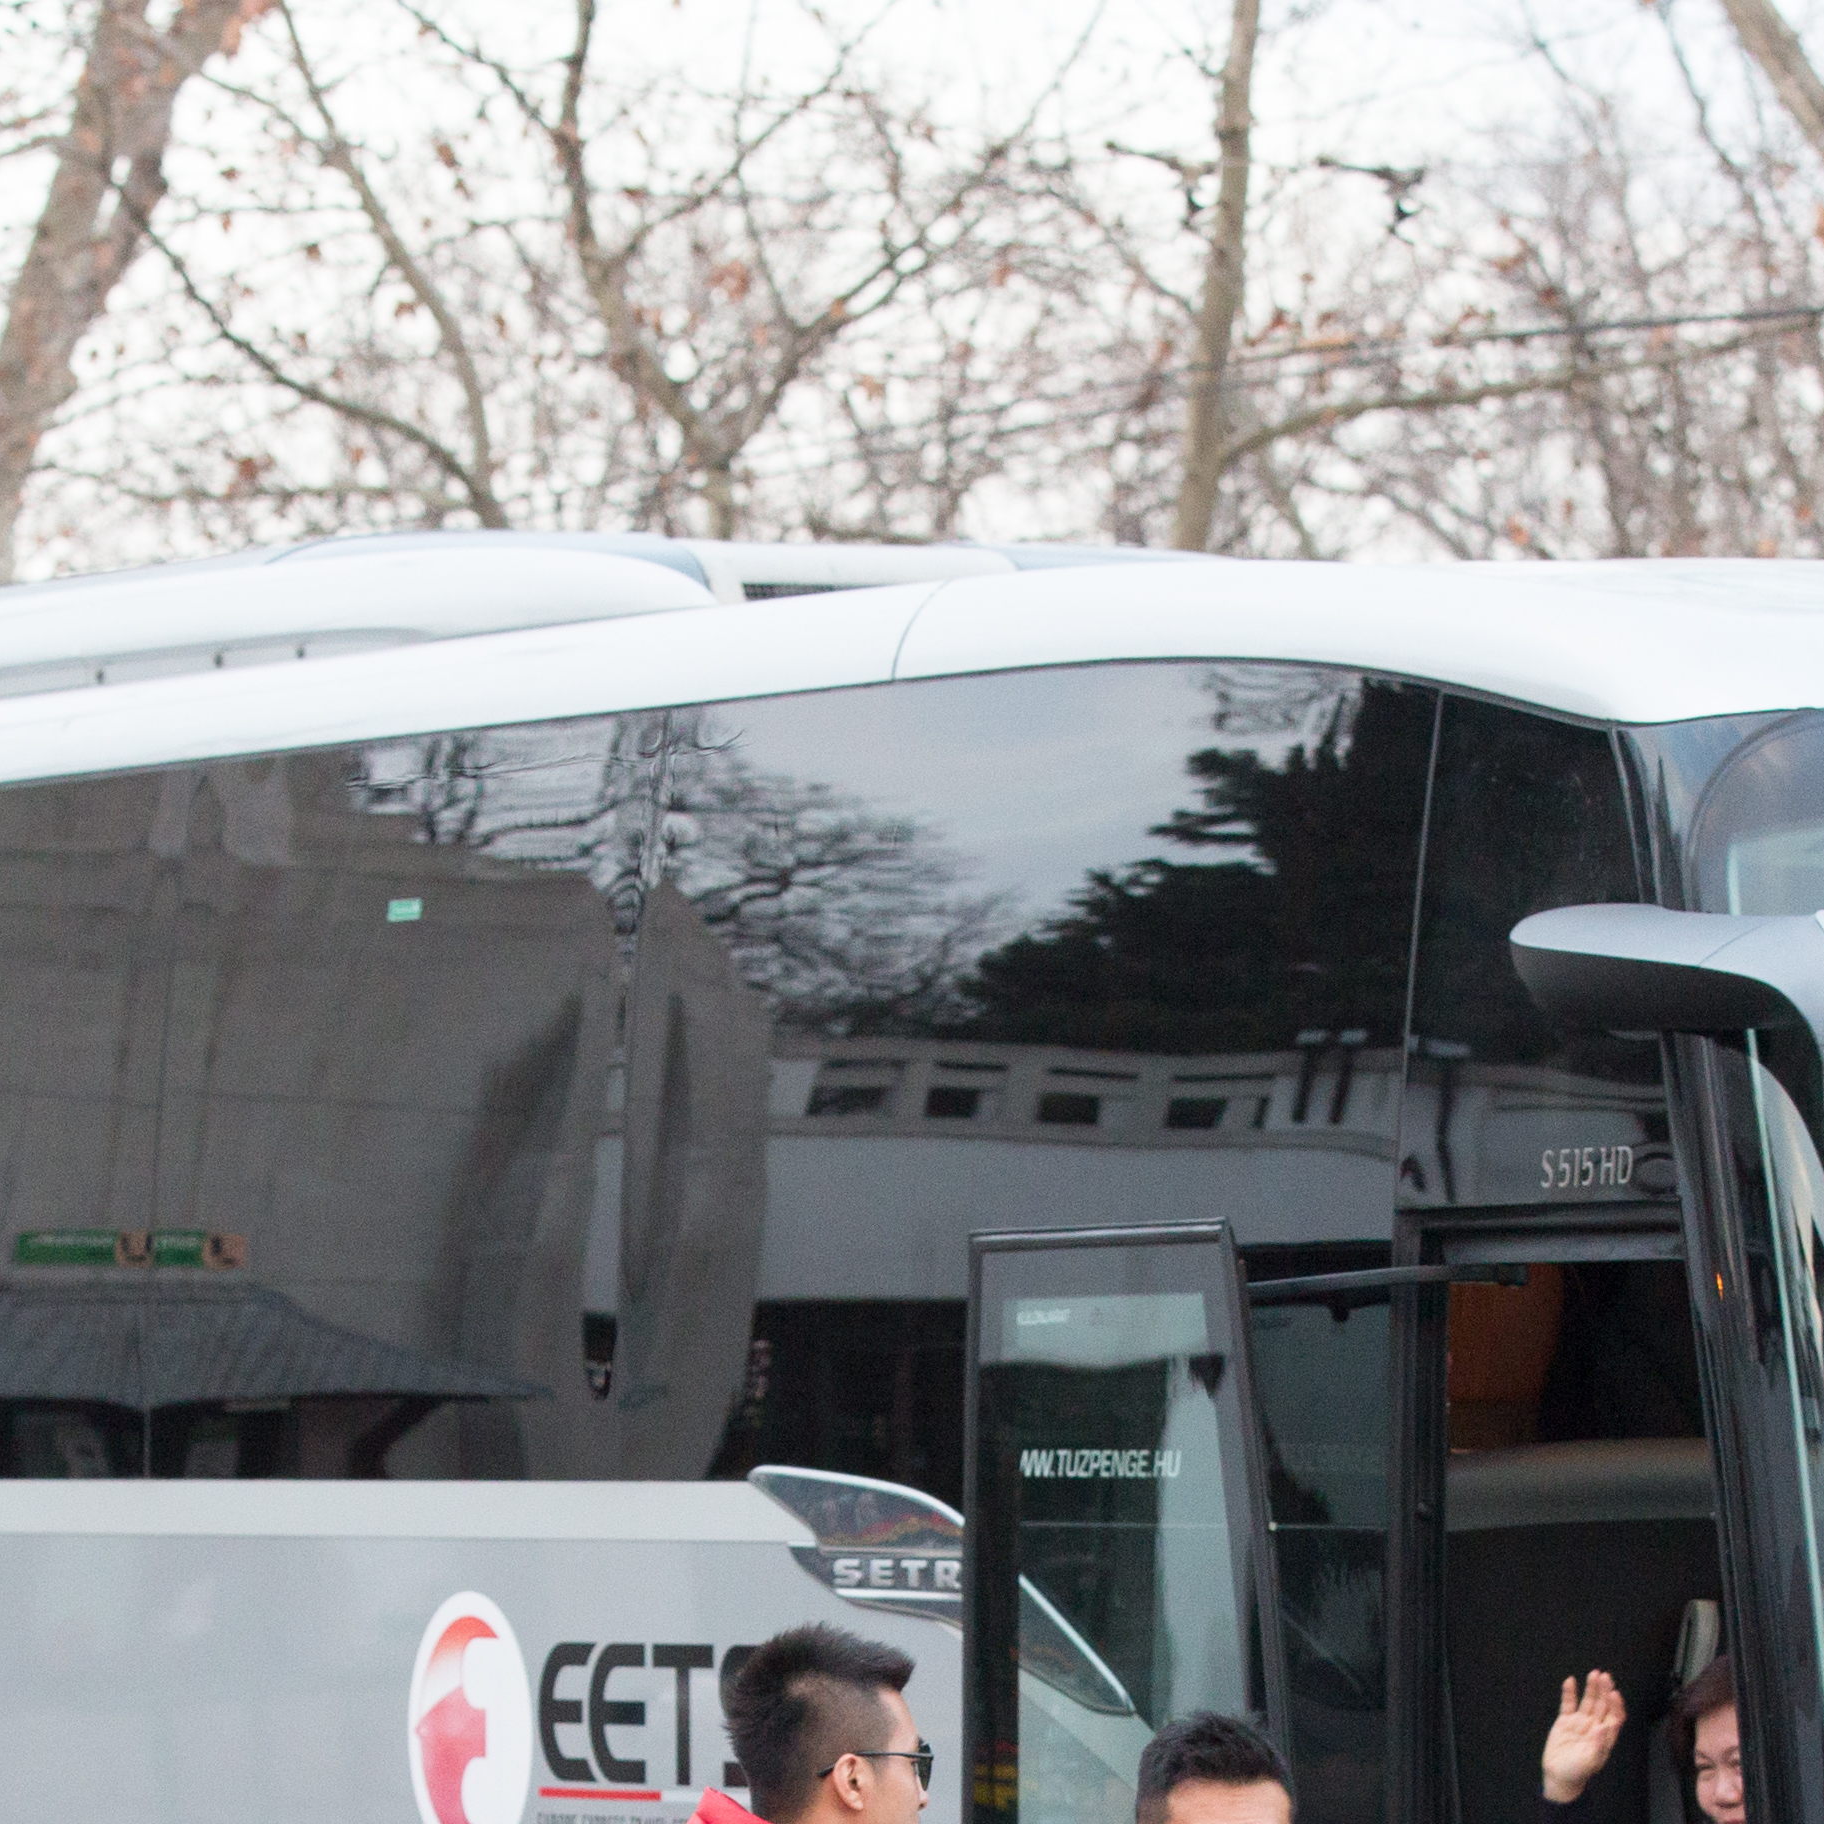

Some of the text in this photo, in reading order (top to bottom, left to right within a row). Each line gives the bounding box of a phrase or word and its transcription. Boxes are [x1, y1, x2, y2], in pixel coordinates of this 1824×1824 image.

[1540, 1145, 1634, 1189] S 515 HD
[832, 1558, 962, 1590] SETR
